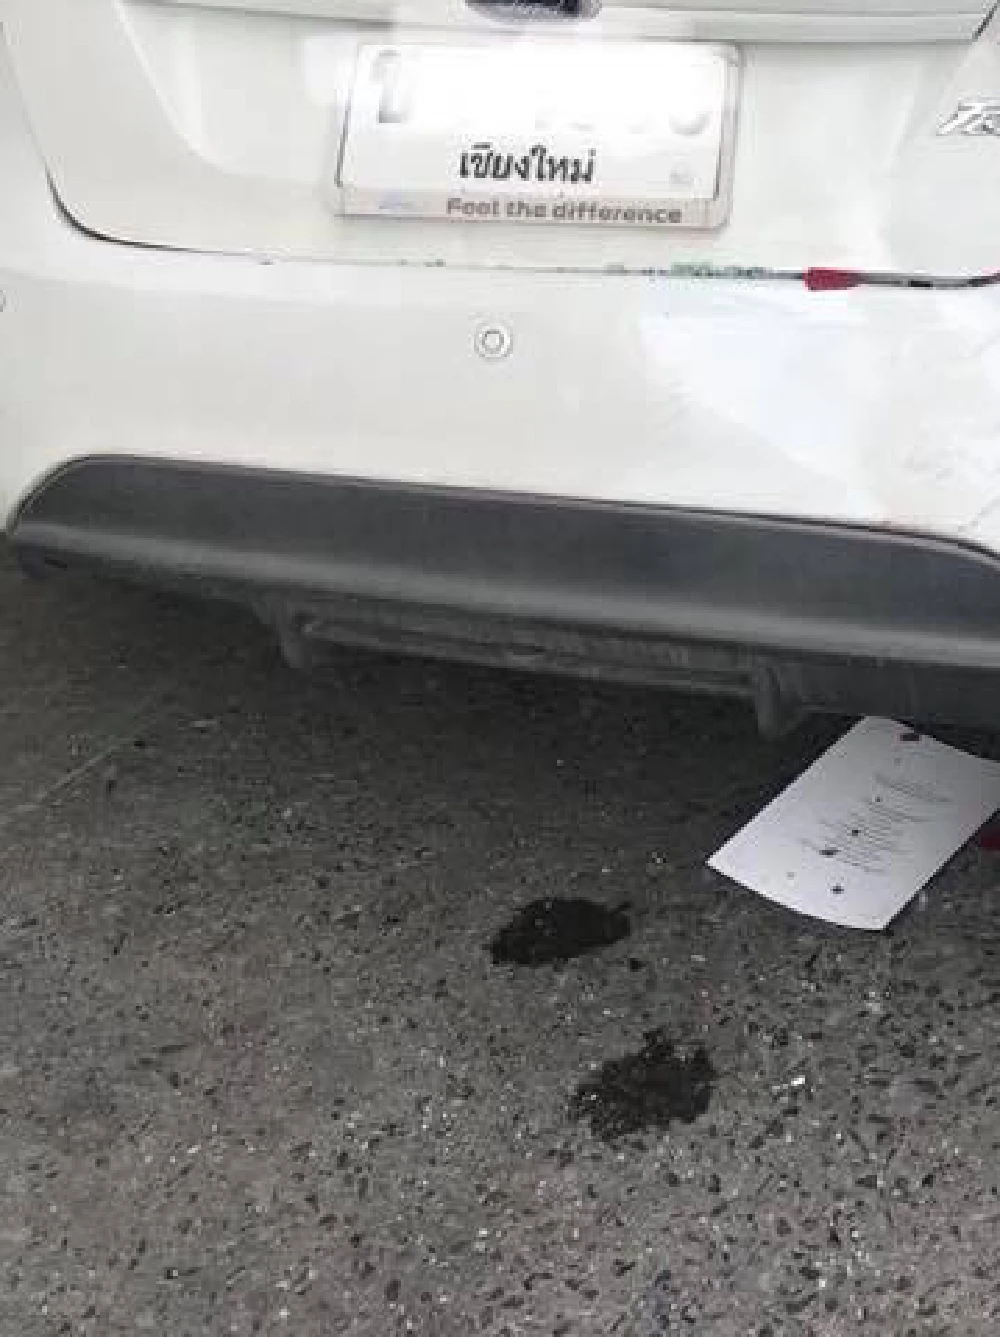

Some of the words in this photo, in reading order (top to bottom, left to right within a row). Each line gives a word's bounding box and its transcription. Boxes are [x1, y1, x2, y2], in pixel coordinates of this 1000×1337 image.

[458, 141, 597, 183] เชียงใหม่
[504, 198, 547, 219] the
[551, 199, 682, 224] difference
